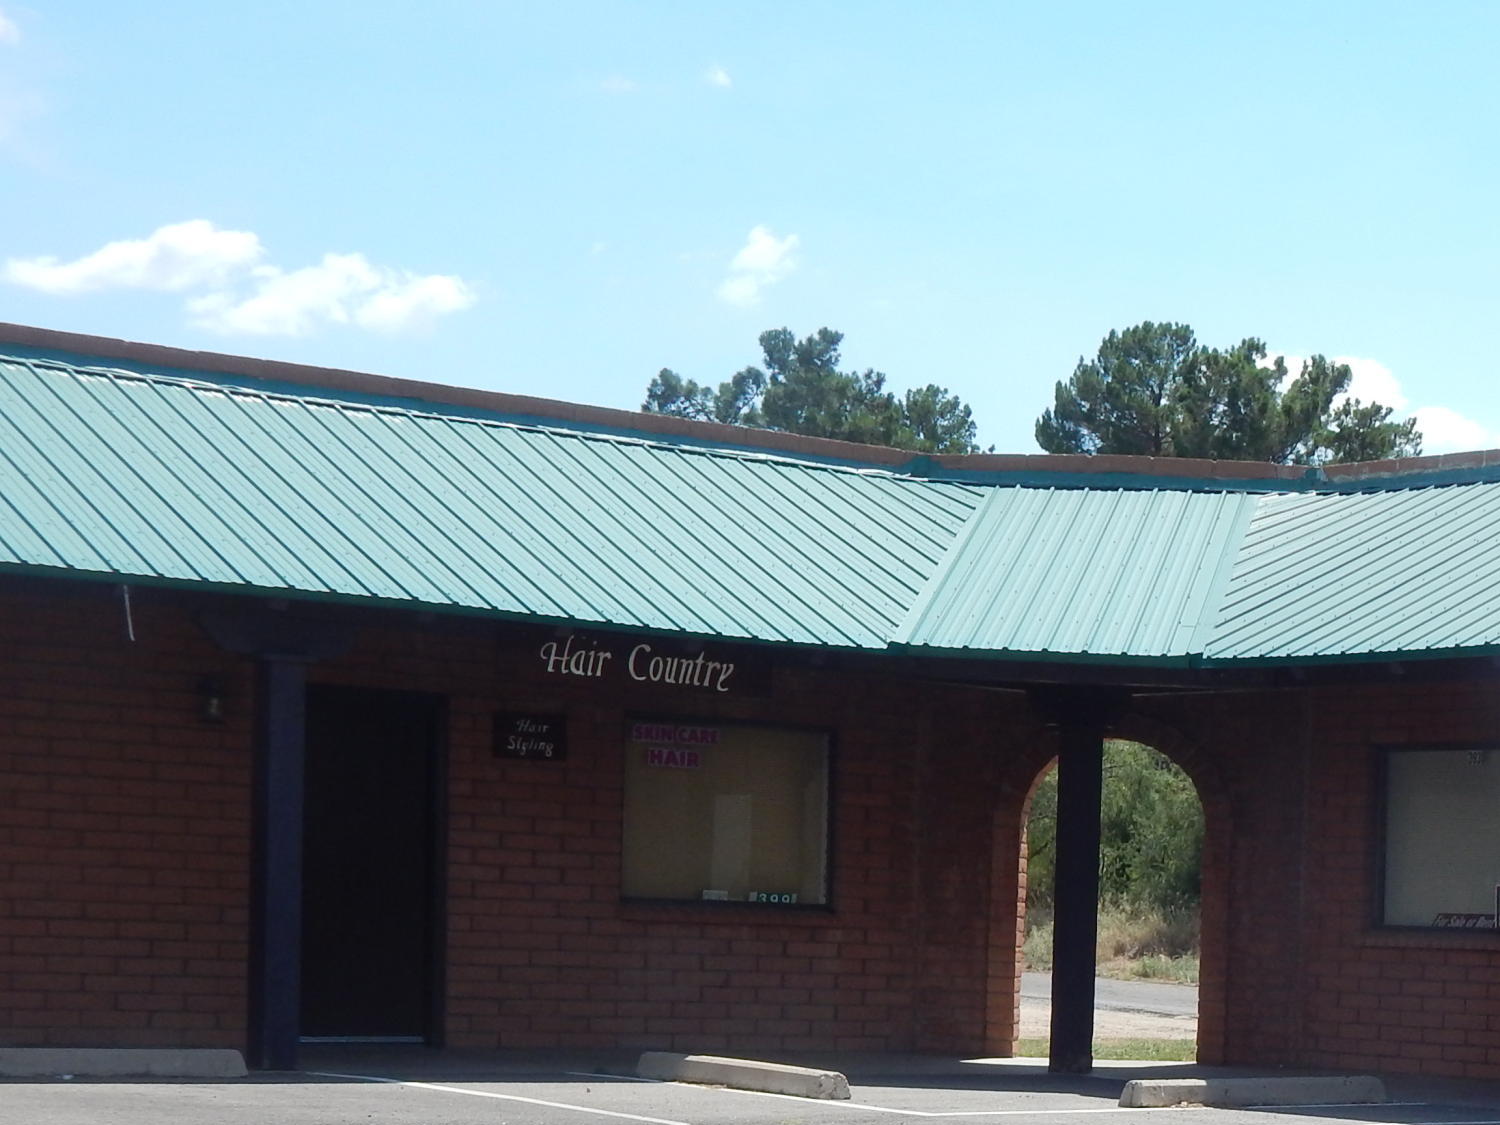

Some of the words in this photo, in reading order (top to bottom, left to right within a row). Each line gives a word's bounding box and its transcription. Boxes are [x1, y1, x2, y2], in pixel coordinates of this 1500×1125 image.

[540, 635, 611, 678] Hair
[628, 644, 735, 692] Country
[515, 719, 550, 734] Hair
[647, 747, 701, 768] HAIR
